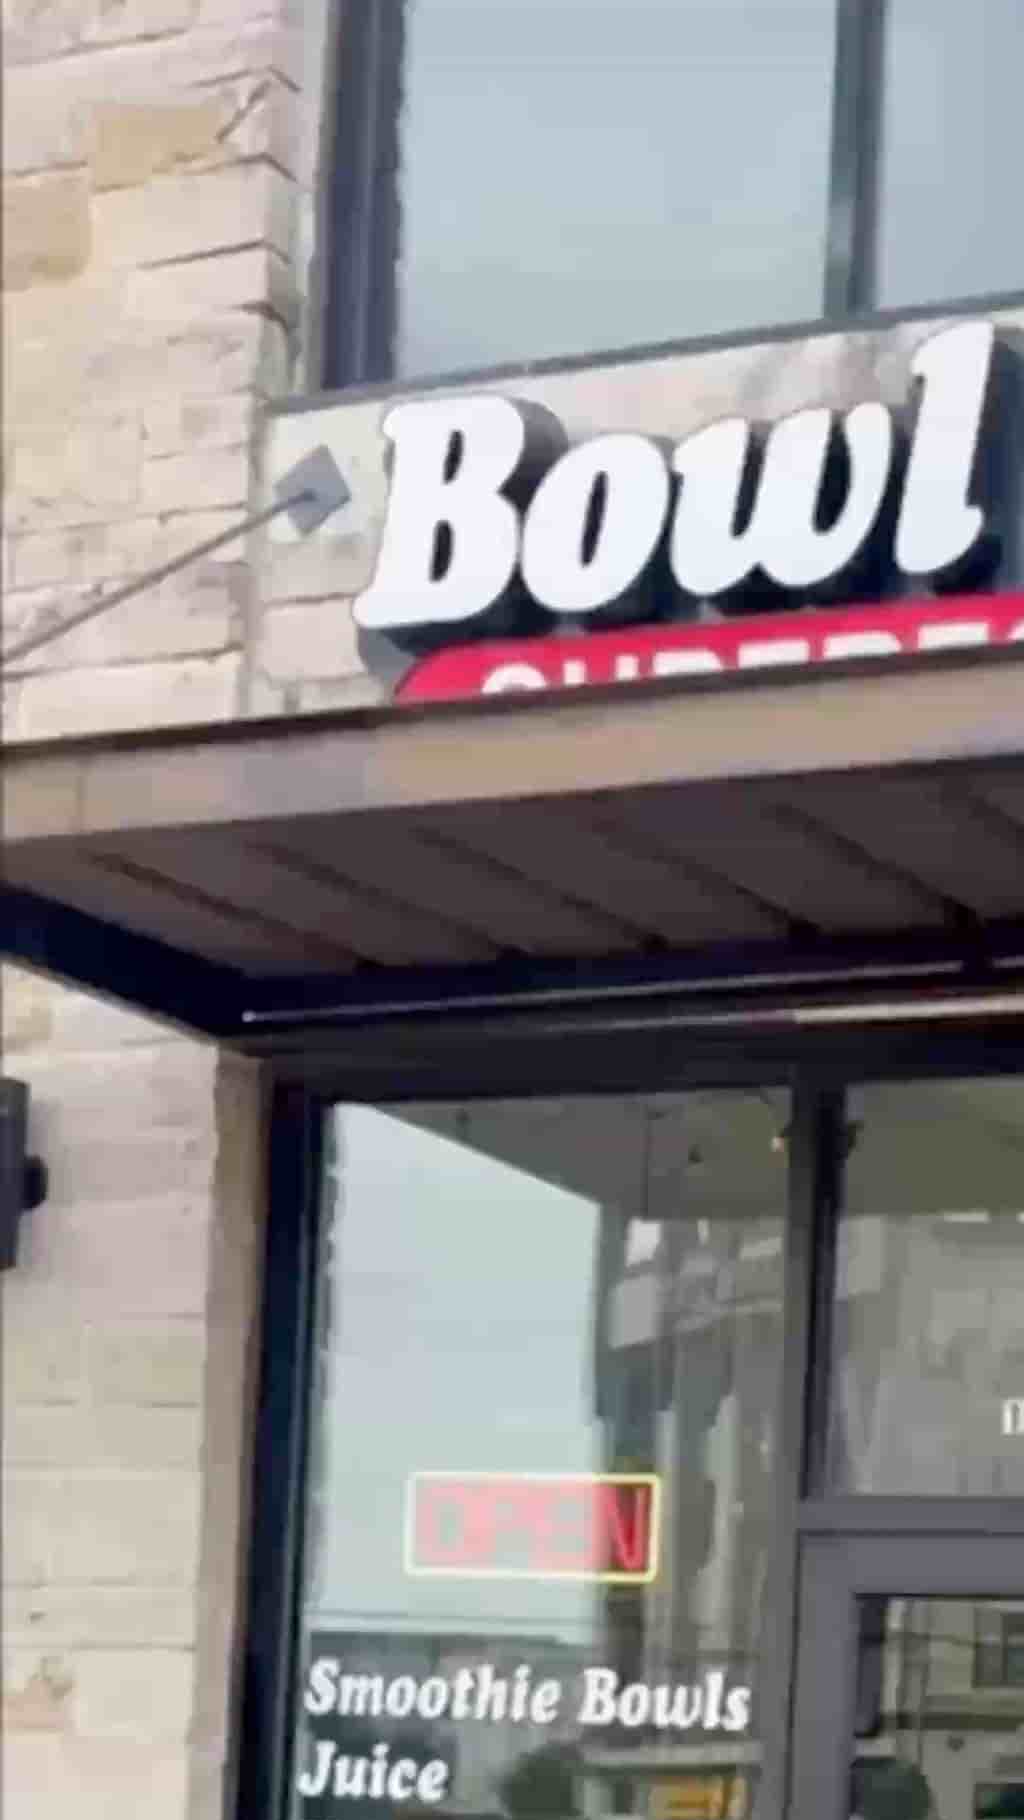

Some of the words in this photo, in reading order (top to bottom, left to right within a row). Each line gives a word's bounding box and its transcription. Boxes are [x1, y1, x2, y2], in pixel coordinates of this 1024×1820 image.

[352, 320, 996, 628] Bowl
[417, 1484, 649, 1571] OPEN
[303, 1657, 562, 1725] Smoothie
[575, 1666, 752, 1731] Bowls
[297, 1741, 449, 1802] Juice
